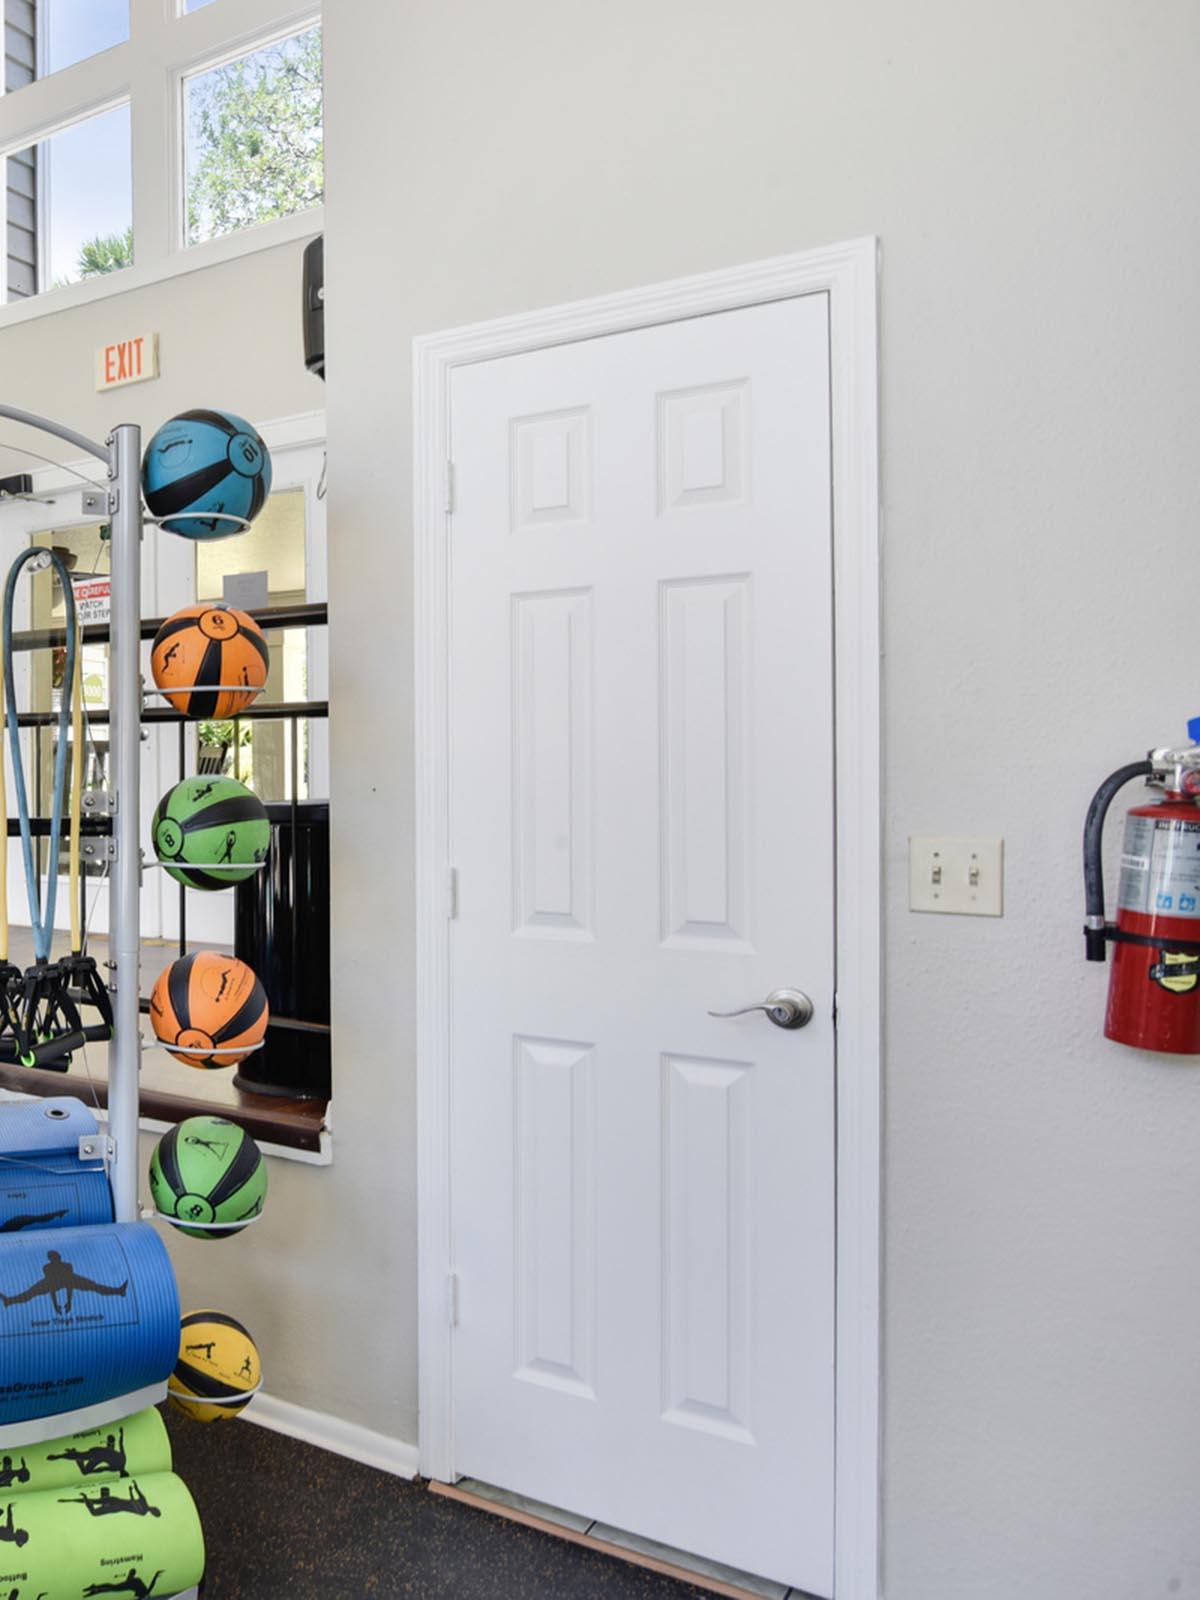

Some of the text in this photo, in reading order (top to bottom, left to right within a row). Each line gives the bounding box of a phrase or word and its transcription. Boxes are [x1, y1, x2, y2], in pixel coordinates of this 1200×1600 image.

[105, 336, 144, 383] EXIT
[79, 610, 92, 620] OUR
[100, 1554, 144, 1567] Hamstring
